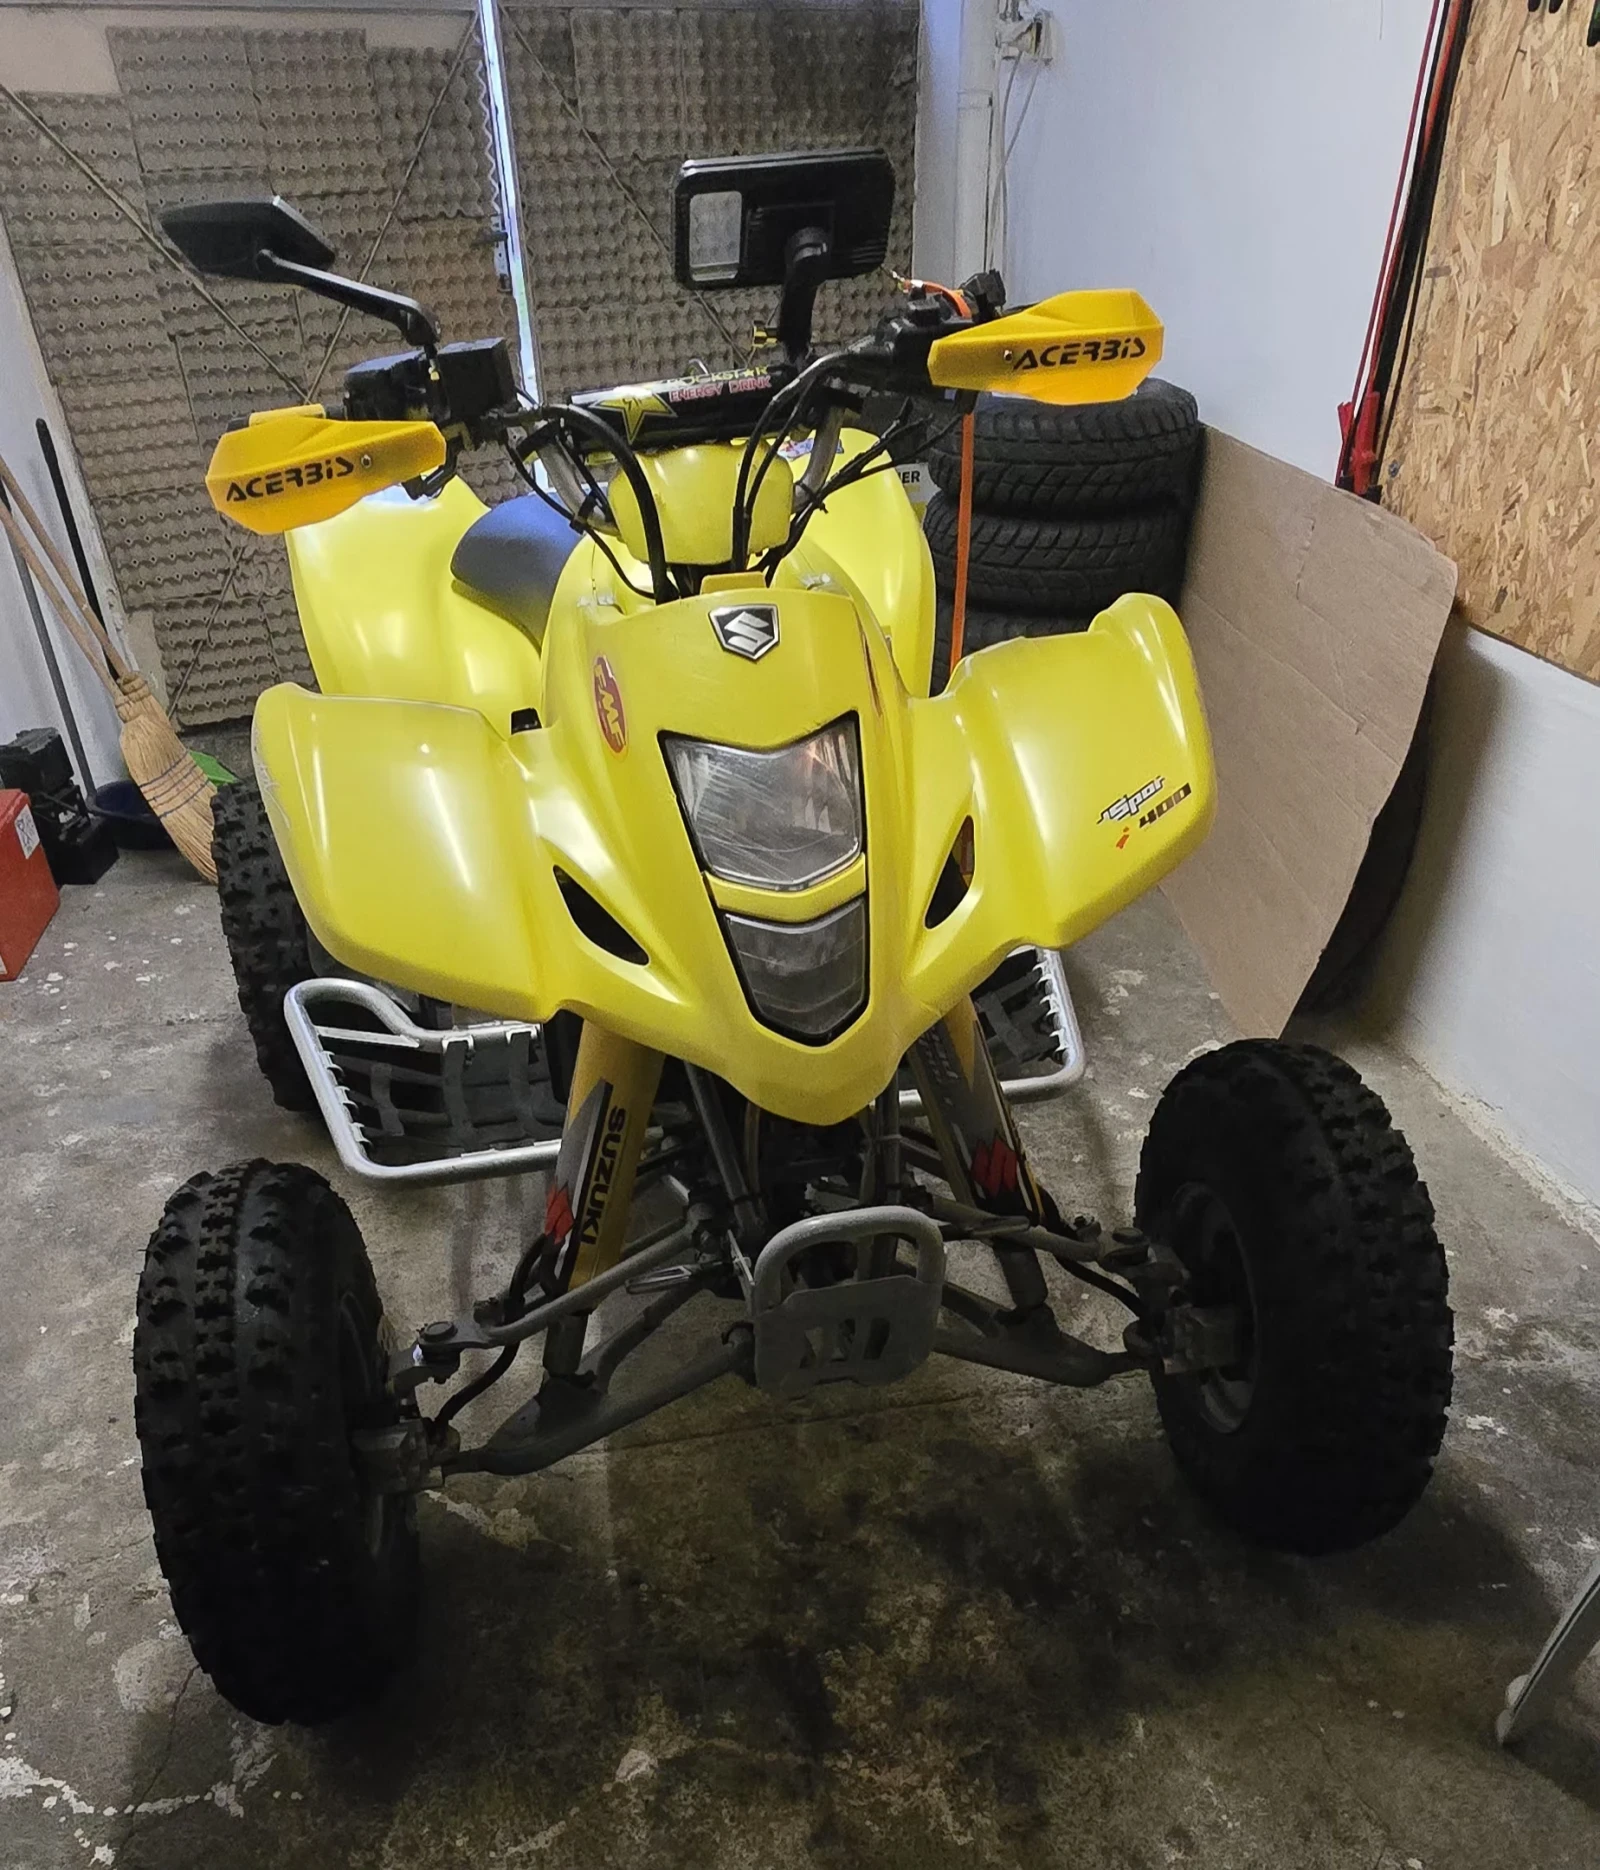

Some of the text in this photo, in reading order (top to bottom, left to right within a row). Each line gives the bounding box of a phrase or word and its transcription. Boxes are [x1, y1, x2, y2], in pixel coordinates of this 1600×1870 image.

[669, 375, 772, 402] ENERGY DRINK
[898, 470, 920, 484] ER
[594, 664, 627, 747] FMF
[580, 1105, 626, 1245] SUZUKI
